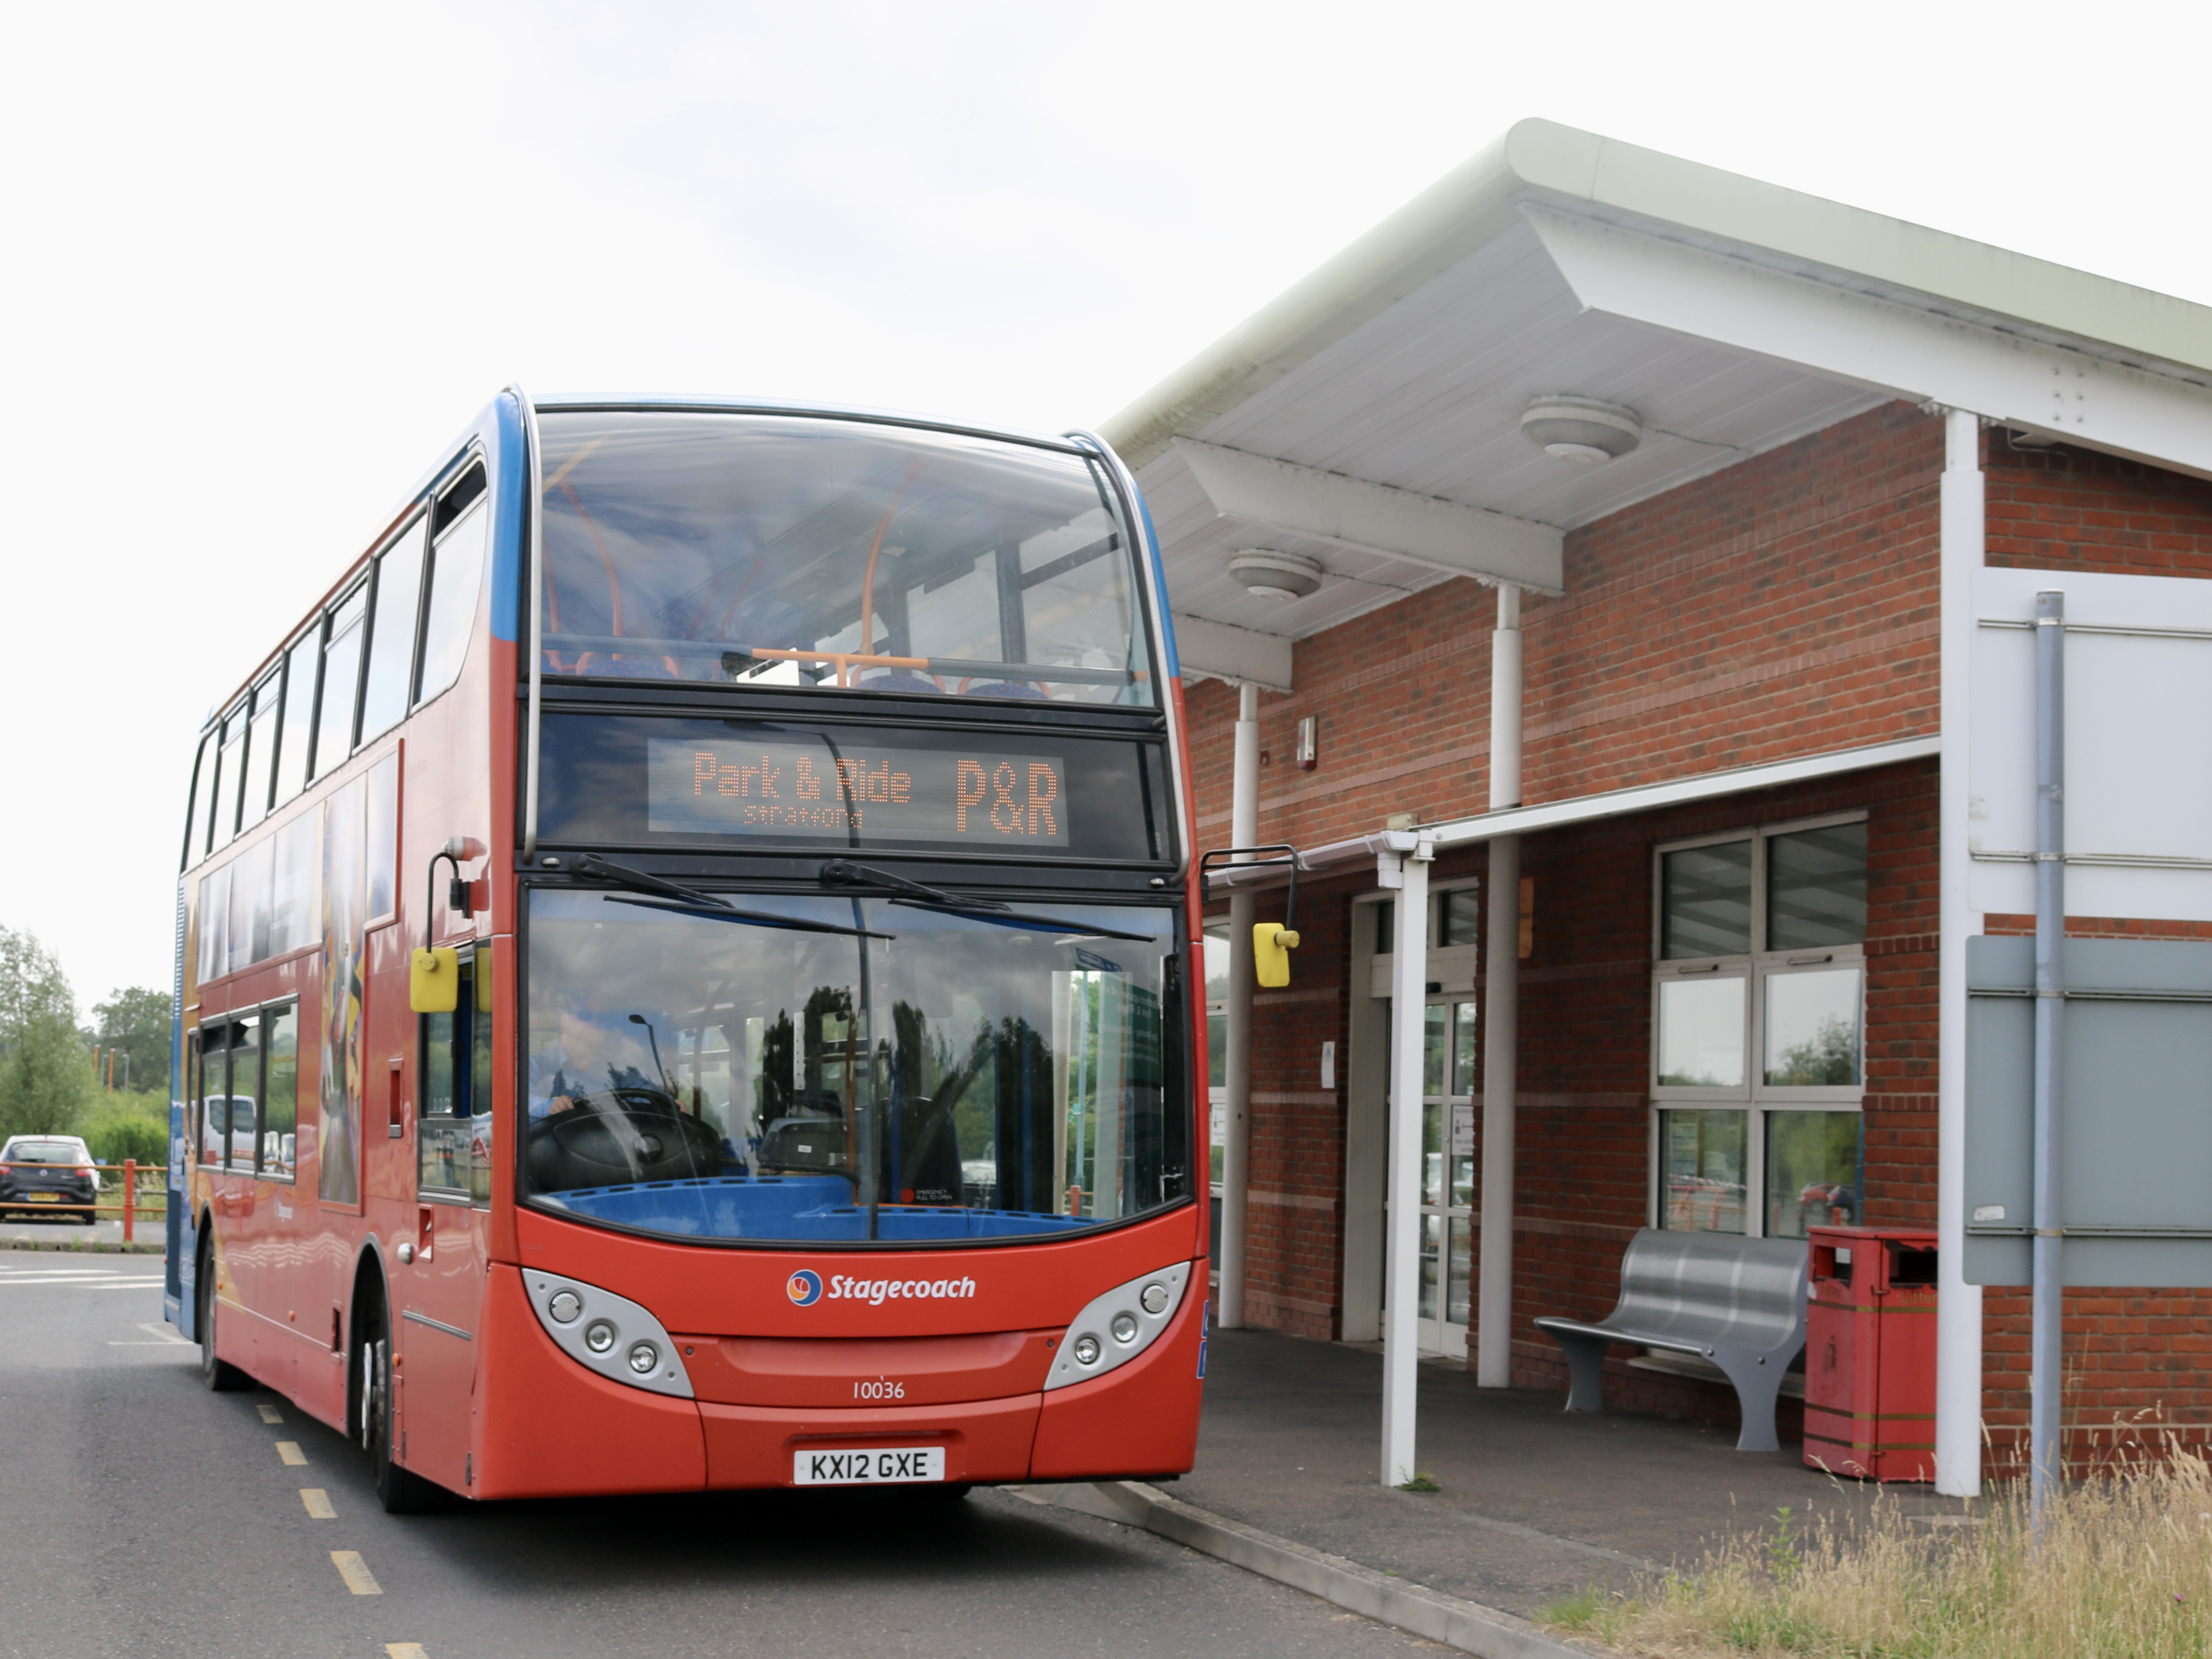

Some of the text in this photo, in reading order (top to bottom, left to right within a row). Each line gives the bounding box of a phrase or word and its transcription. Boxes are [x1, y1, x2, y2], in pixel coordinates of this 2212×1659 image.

[695, 753, 910, 803] Park & Ride
[957, 760, 1056, 835] P&R
[827, 1274, 976, 1305] Stagecoach
[854, 1382, 905, 1399] 10036
[811, 1453, 928, 1479] KX12 GXE
